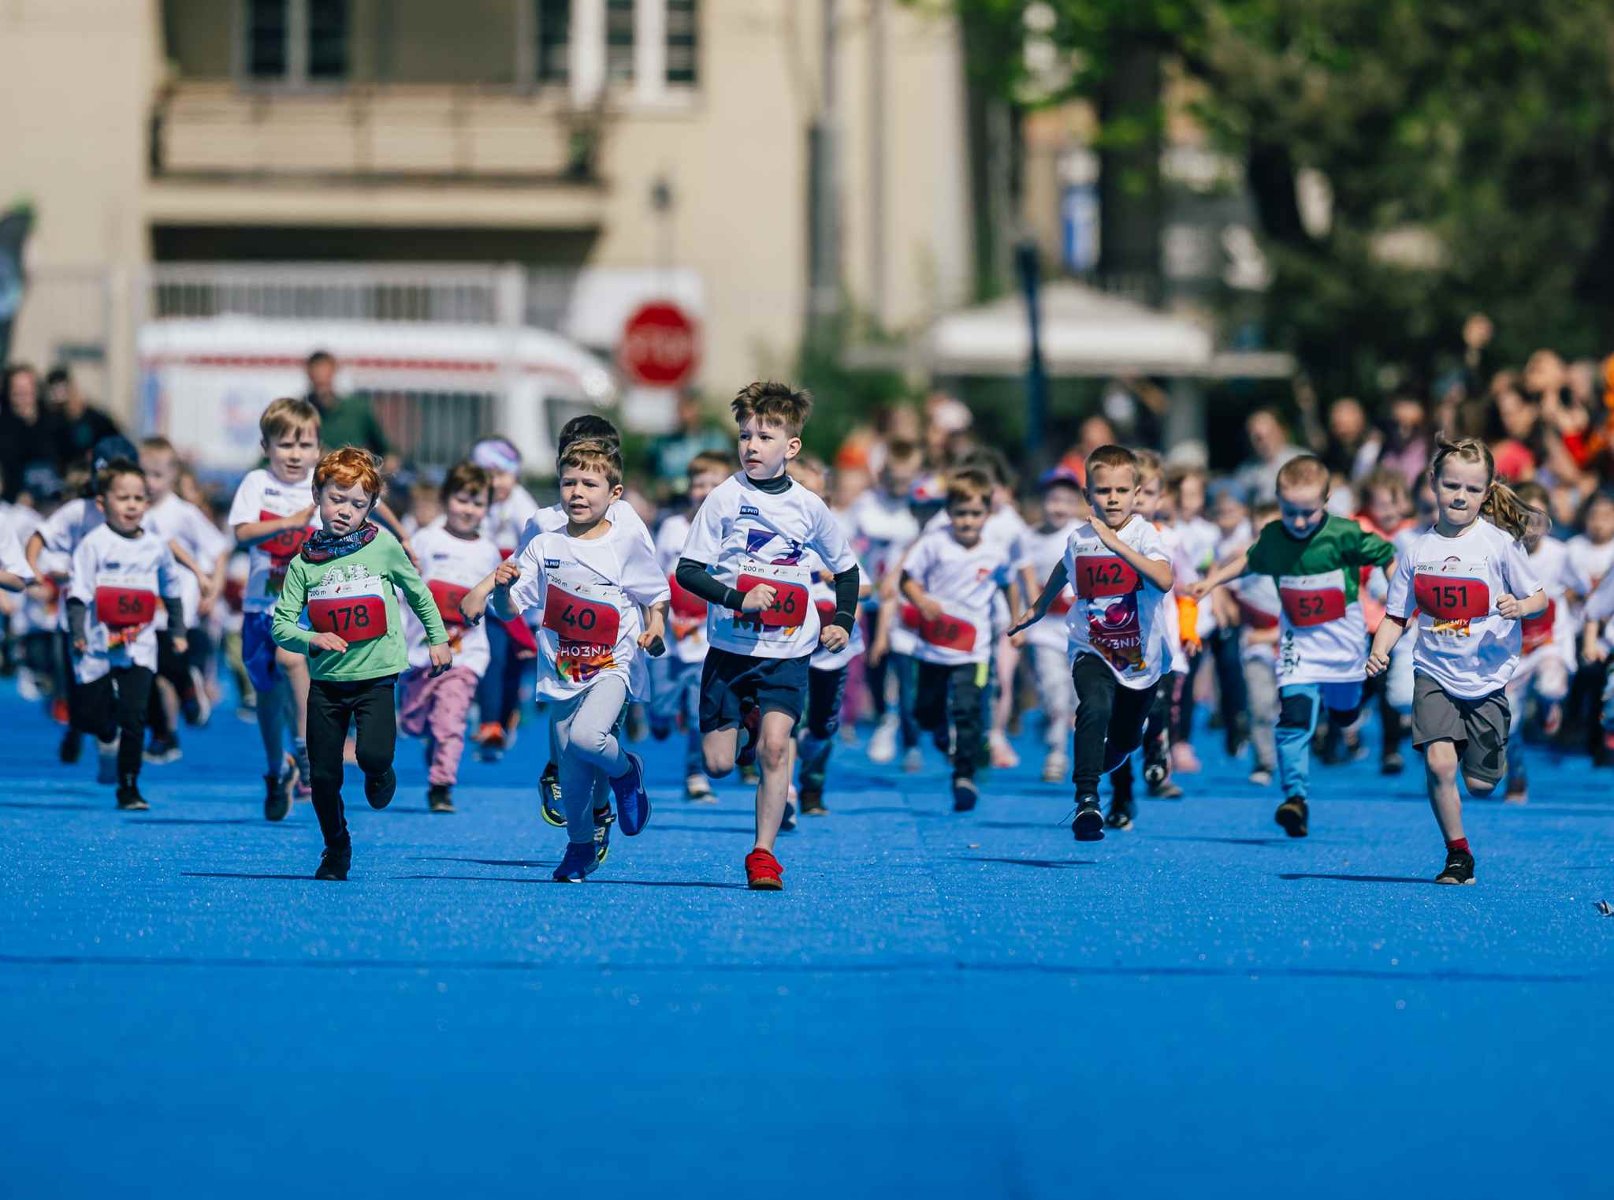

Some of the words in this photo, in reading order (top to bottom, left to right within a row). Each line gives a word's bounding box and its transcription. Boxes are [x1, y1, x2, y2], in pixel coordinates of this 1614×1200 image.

[1086, 563, 1125, 587] 142
[118, 594, 144, 615] 56
[1299, 595, 1326, 618] 52
[1432, 586, 1468, 608] 151
[327, 604, 370, 632] 178
[561, 604, 597, 631] 40
